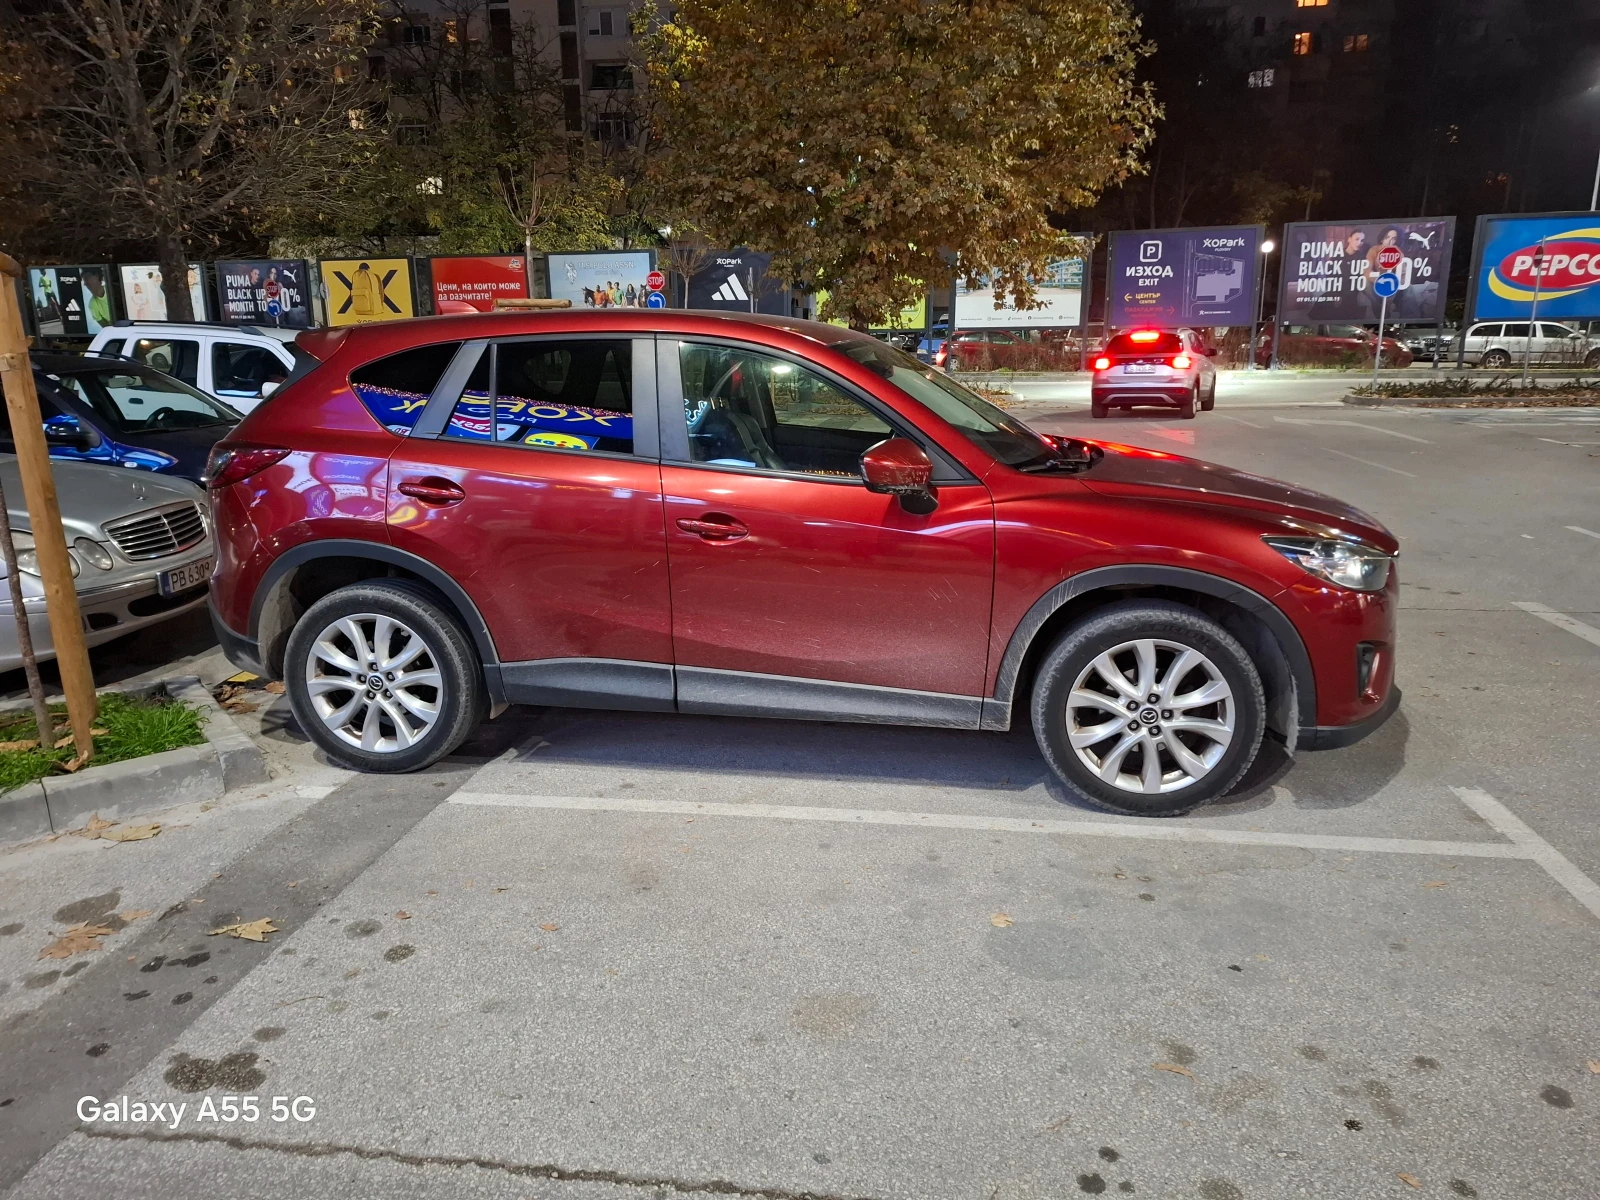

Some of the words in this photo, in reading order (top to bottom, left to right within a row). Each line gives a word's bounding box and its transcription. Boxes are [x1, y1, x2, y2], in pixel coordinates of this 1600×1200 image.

[1202, 237, 1245, 248] XOPark
[1146, 246, 1156, 257] P
[1300, 241, 1345, 259] PUMA
[716, 257, 742, 265] XOPark
[1379, 252, 1400, 263] STOP
[578, 261, 592, 270] U.S.
[593, 261, 613, 269] POLO
[614, 260, 636, 269] ASSN.
[1298, 260, 1342, 276] BLACK
[1350, 259, 1370, 276] UP
[1125, 265, 1174, 278] ИЗХОД
[225, 275, 251, 287] PUMA
[647, 276, 663, 285] STOP
[1138, 278, 1160, 287] EXIT
[1297, 276, 1342, 292] MONTH
[1349, 275, 1367, 291] TO
[436, 282, 460, 292] Цени,
[498, 282, 521, 290] може
[227, 288, 252, 300] BLACK
[255, 288, 267, 300] UP
[438, 293, 448, 301] да
[449, 291, 492, 301] разчитате!
[229, 301, 254, 312] MONTH
[256, 300, 267, 312] TO
[171, 570, 186, 590] PB
